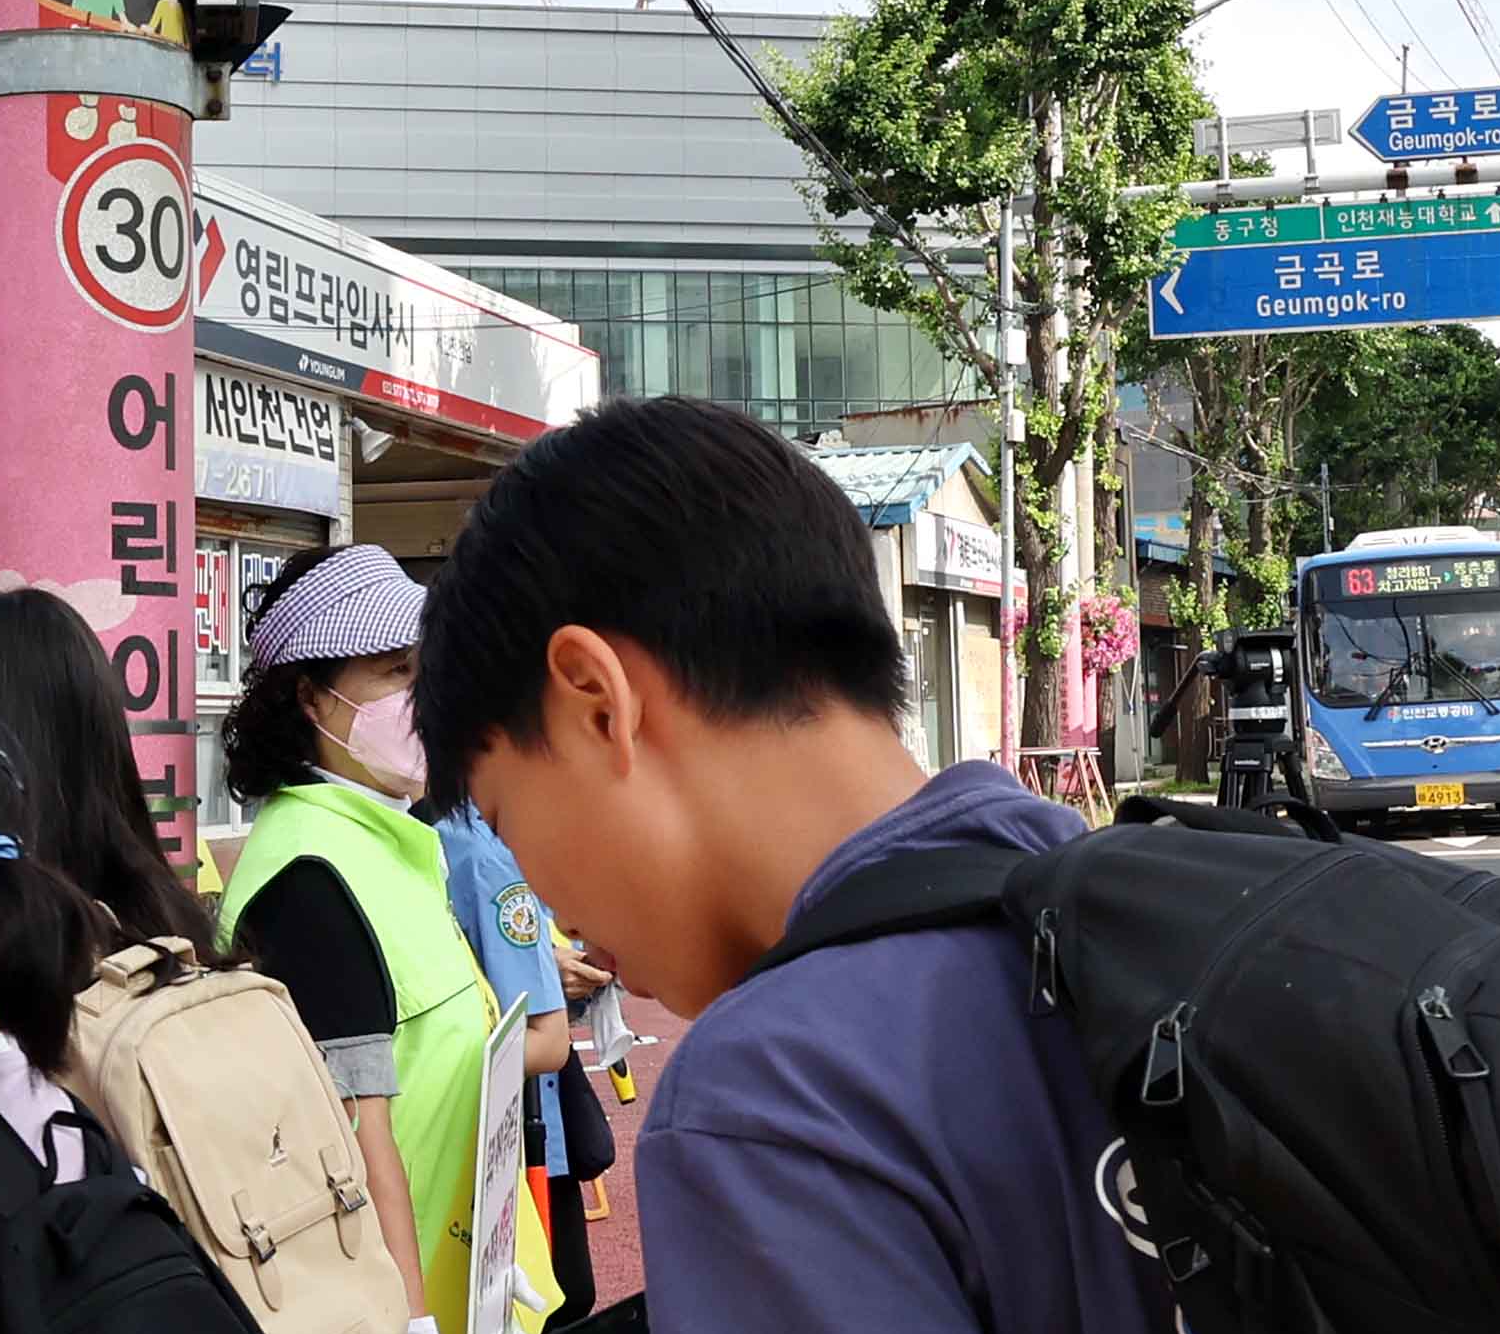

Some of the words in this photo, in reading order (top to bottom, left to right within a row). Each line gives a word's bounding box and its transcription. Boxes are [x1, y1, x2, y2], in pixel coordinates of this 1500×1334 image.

[94, 187, 185, 281] 30
[1213, 216, 1279, 242] 동구청
[1337, 203, 1478, 234] 인천재능대학교
[1274, 250, 1385, 290] 금곡로
[1256, 290, 1407, 318] Geumgok-ro
[1348, 568, 1376, 596] 63
